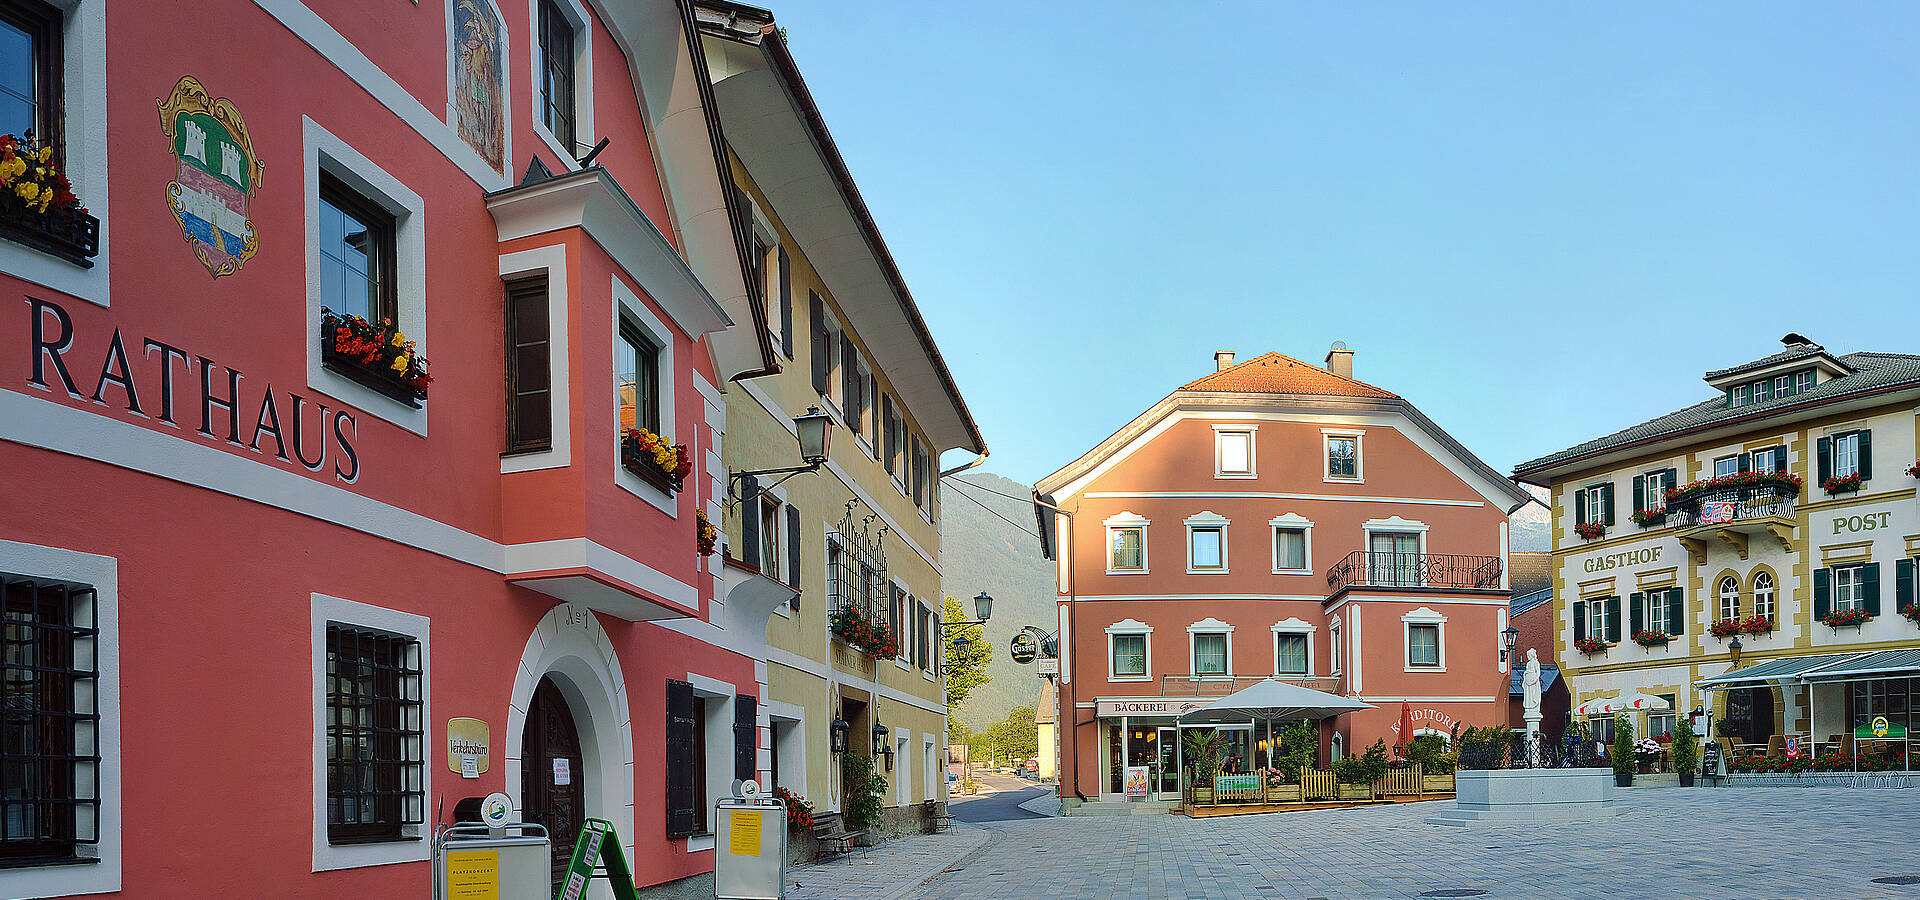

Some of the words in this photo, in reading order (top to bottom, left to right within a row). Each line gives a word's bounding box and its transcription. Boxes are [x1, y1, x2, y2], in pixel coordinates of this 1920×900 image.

[24, 294, 359, 484] RATHAUS
[1832, 511, 1892, 535] POST
[1584, 545, 1663, 573] GASTHOF
[1114, 701, 1168, 712] BÄCKEREI
[449, 739, 488, 756] Verkehrsbüro
